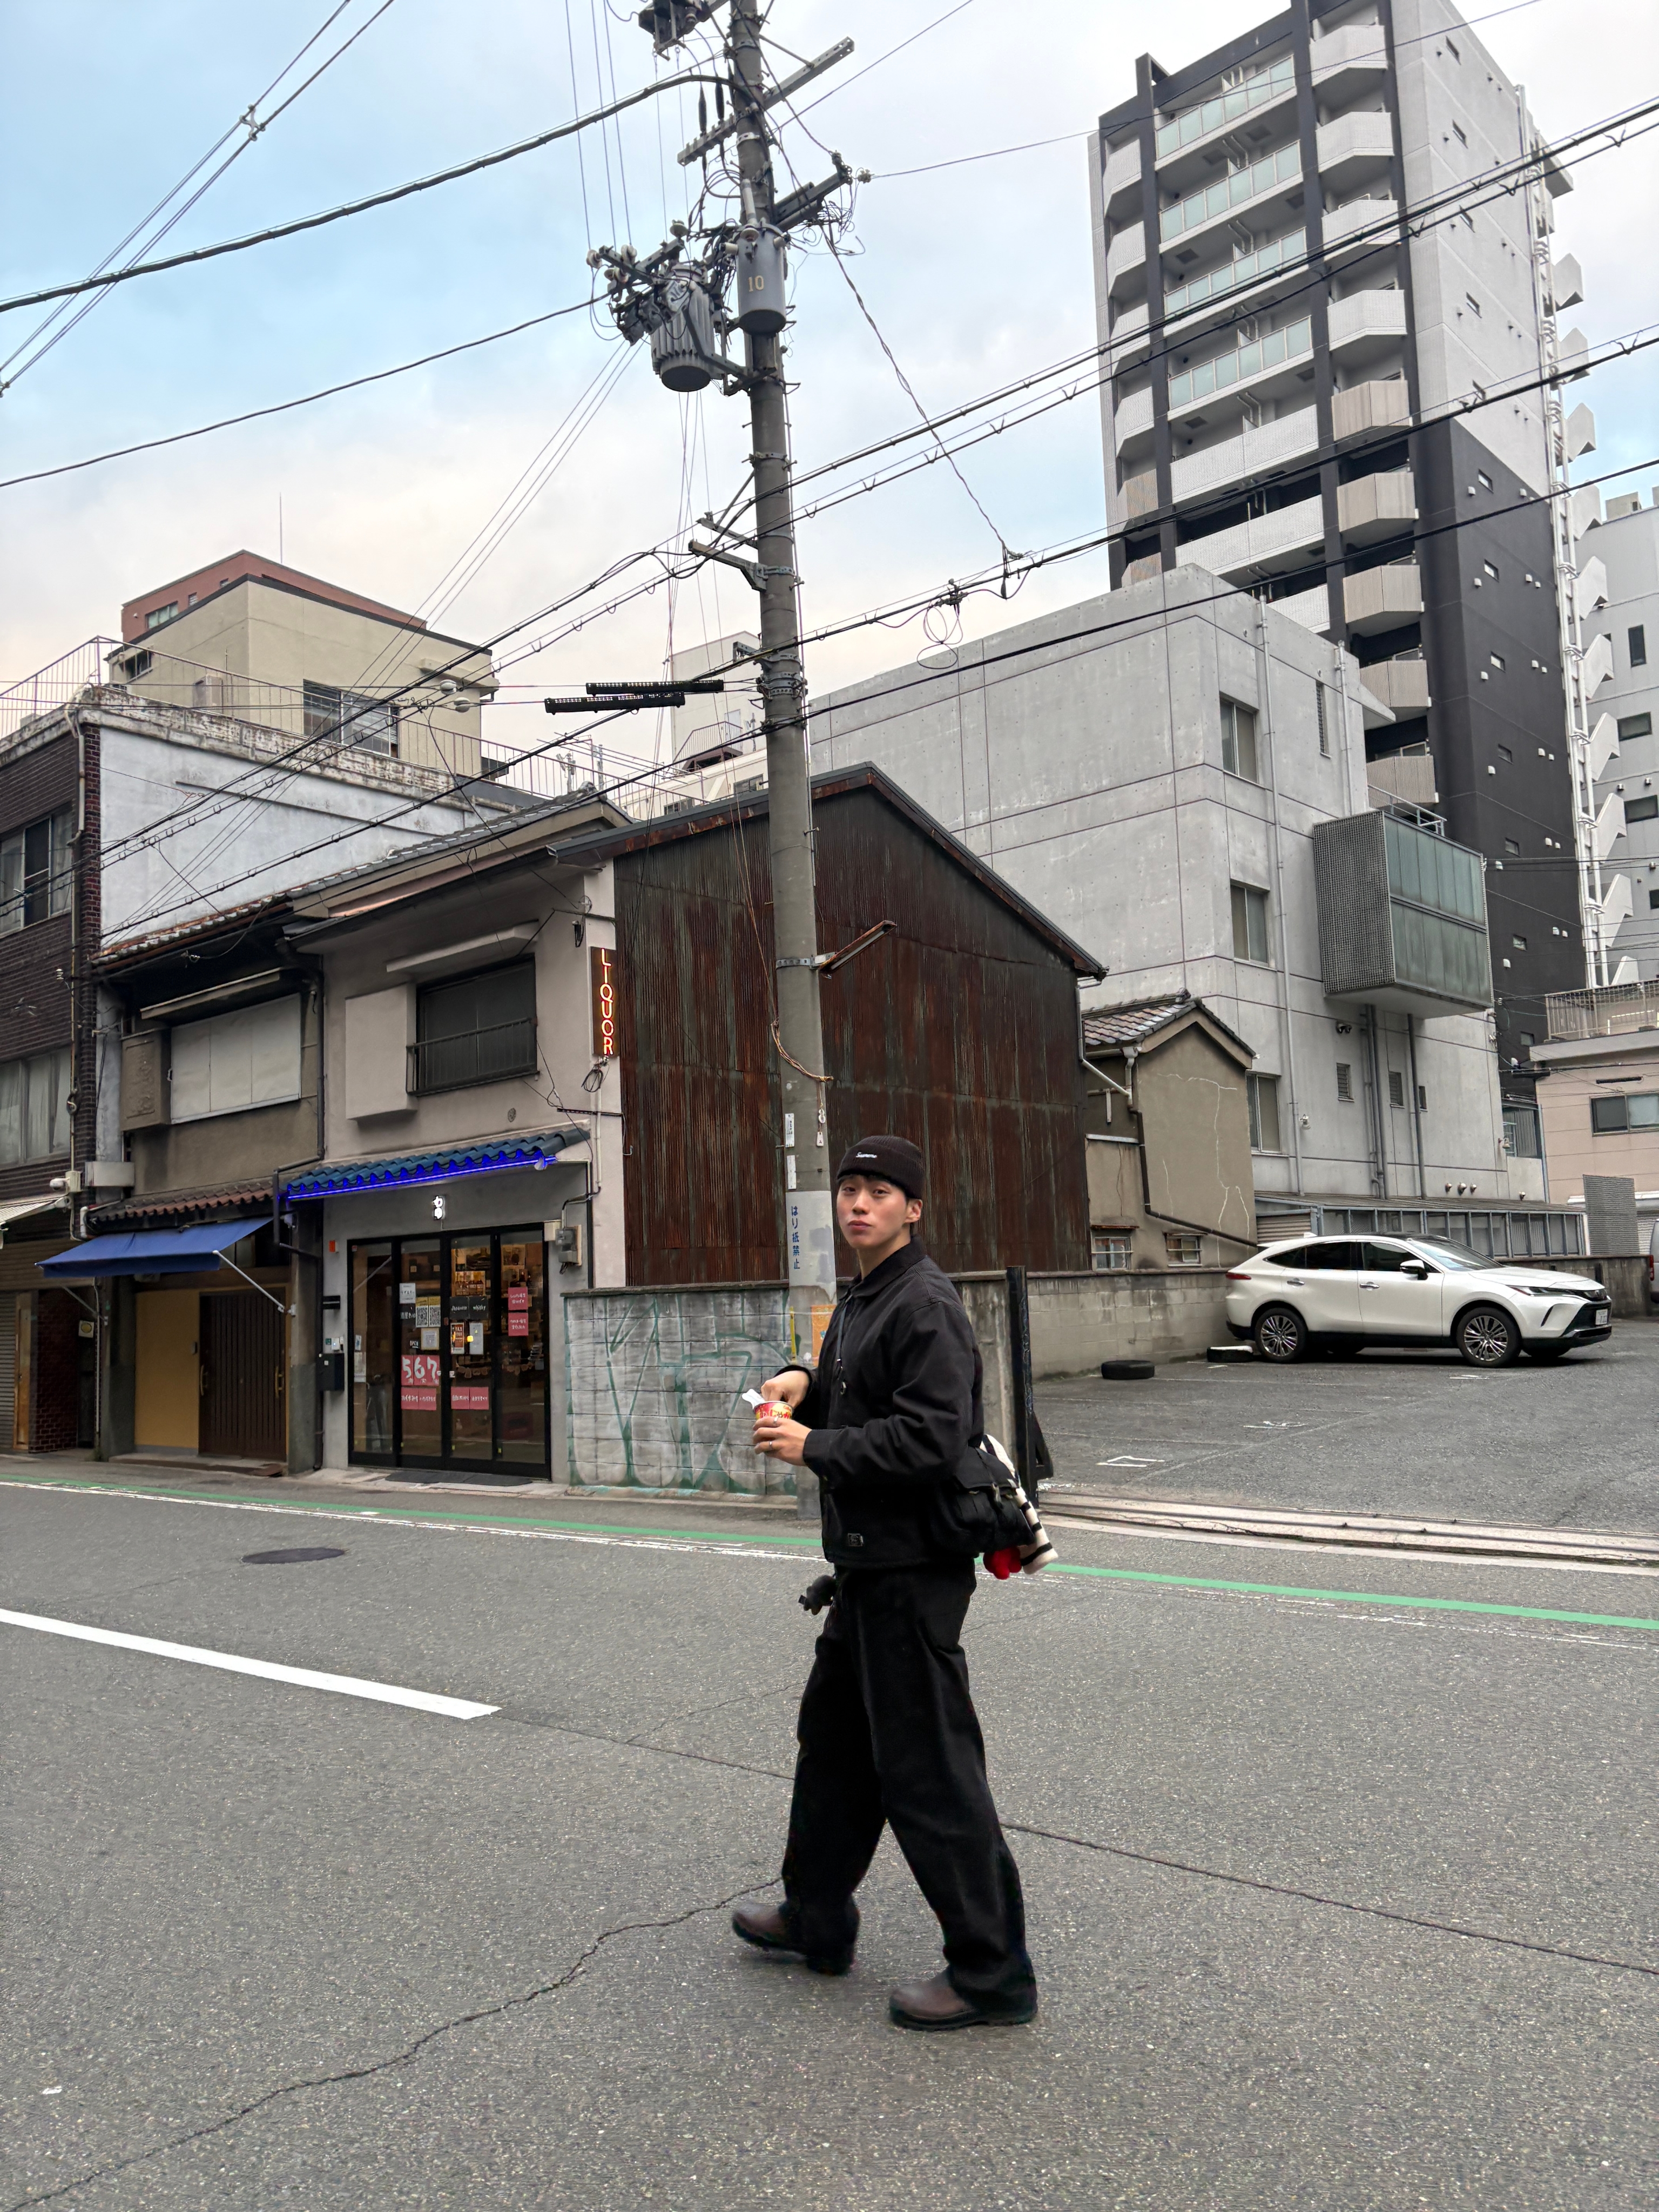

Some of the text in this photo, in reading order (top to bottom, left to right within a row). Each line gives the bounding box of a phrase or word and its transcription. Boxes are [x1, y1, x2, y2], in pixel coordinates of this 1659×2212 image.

[748, 275, 764, 292] 10
[600, 948, 614, 1055] LIQUOR
[791, 1205, 800, 1269] はり紙禁止
